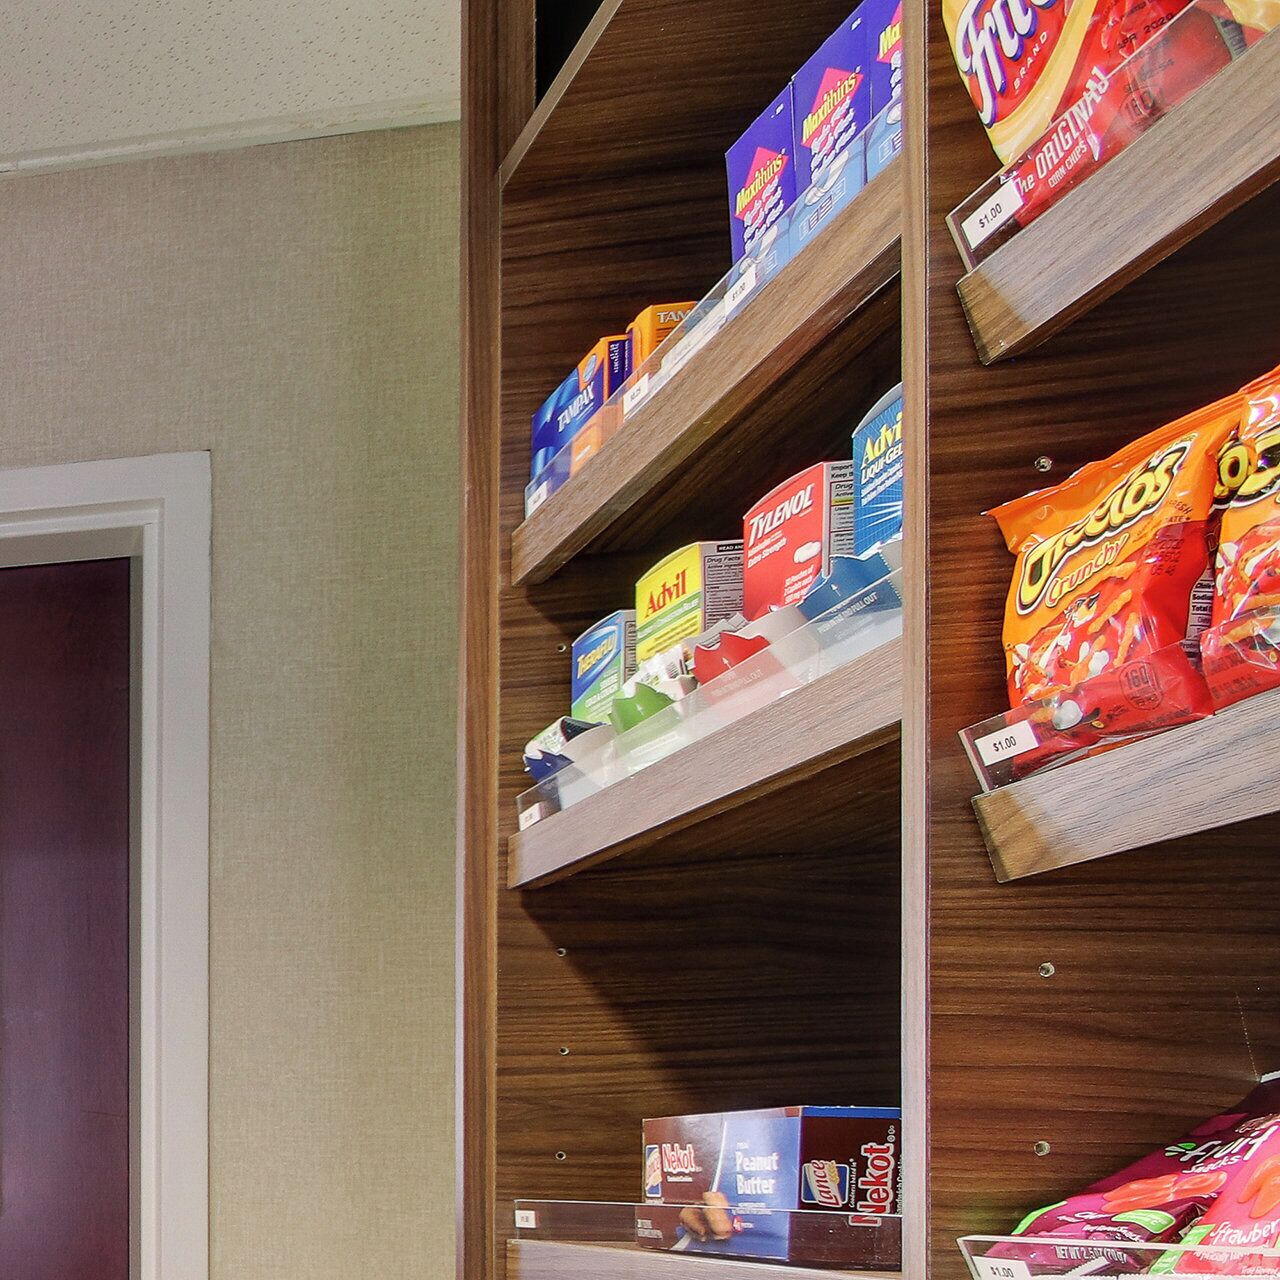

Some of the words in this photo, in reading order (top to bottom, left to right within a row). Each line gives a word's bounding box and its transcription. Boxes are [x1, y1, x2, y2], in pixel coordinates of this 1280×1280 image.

[1013, 31, 1048, 91] BRAND
[802, 71, 857, 144] Maxithins
[1035, 66, 1110, 179] ORIGINAL
[735, 155, 783, 215] Maxithins
[1048, 165, 1067, 188] CORN
[1064, 139, 1088, 170] CHIPS
[978, 203, 1003, 229] $1.00
[557, 382, 596, 433] TAMPAX
[835, 483, 853, 491] Drug
[748, 483, 815, 548] TYLENOL
[644, 569, 687, 618] Advil
[1046, 533, 1129, 609] Crunchy
[864, 591, 878, 606] OUT
[993, 735, 1017, 753] $1.00
[661, 1143, 695, 1174] Nekot
[735, 1151, 779, 1171] Peanut
[736, 1174, 776, 1195] Butter
[811, 1160, 842, 1207] Lance
[849, 1143, 894, 1227] Nekot
[990, 1265, 1014, 1279] $1.00
[1056, 1245, 1069, 1259] NET
[1070, 1246, 1081, 1259] WT
